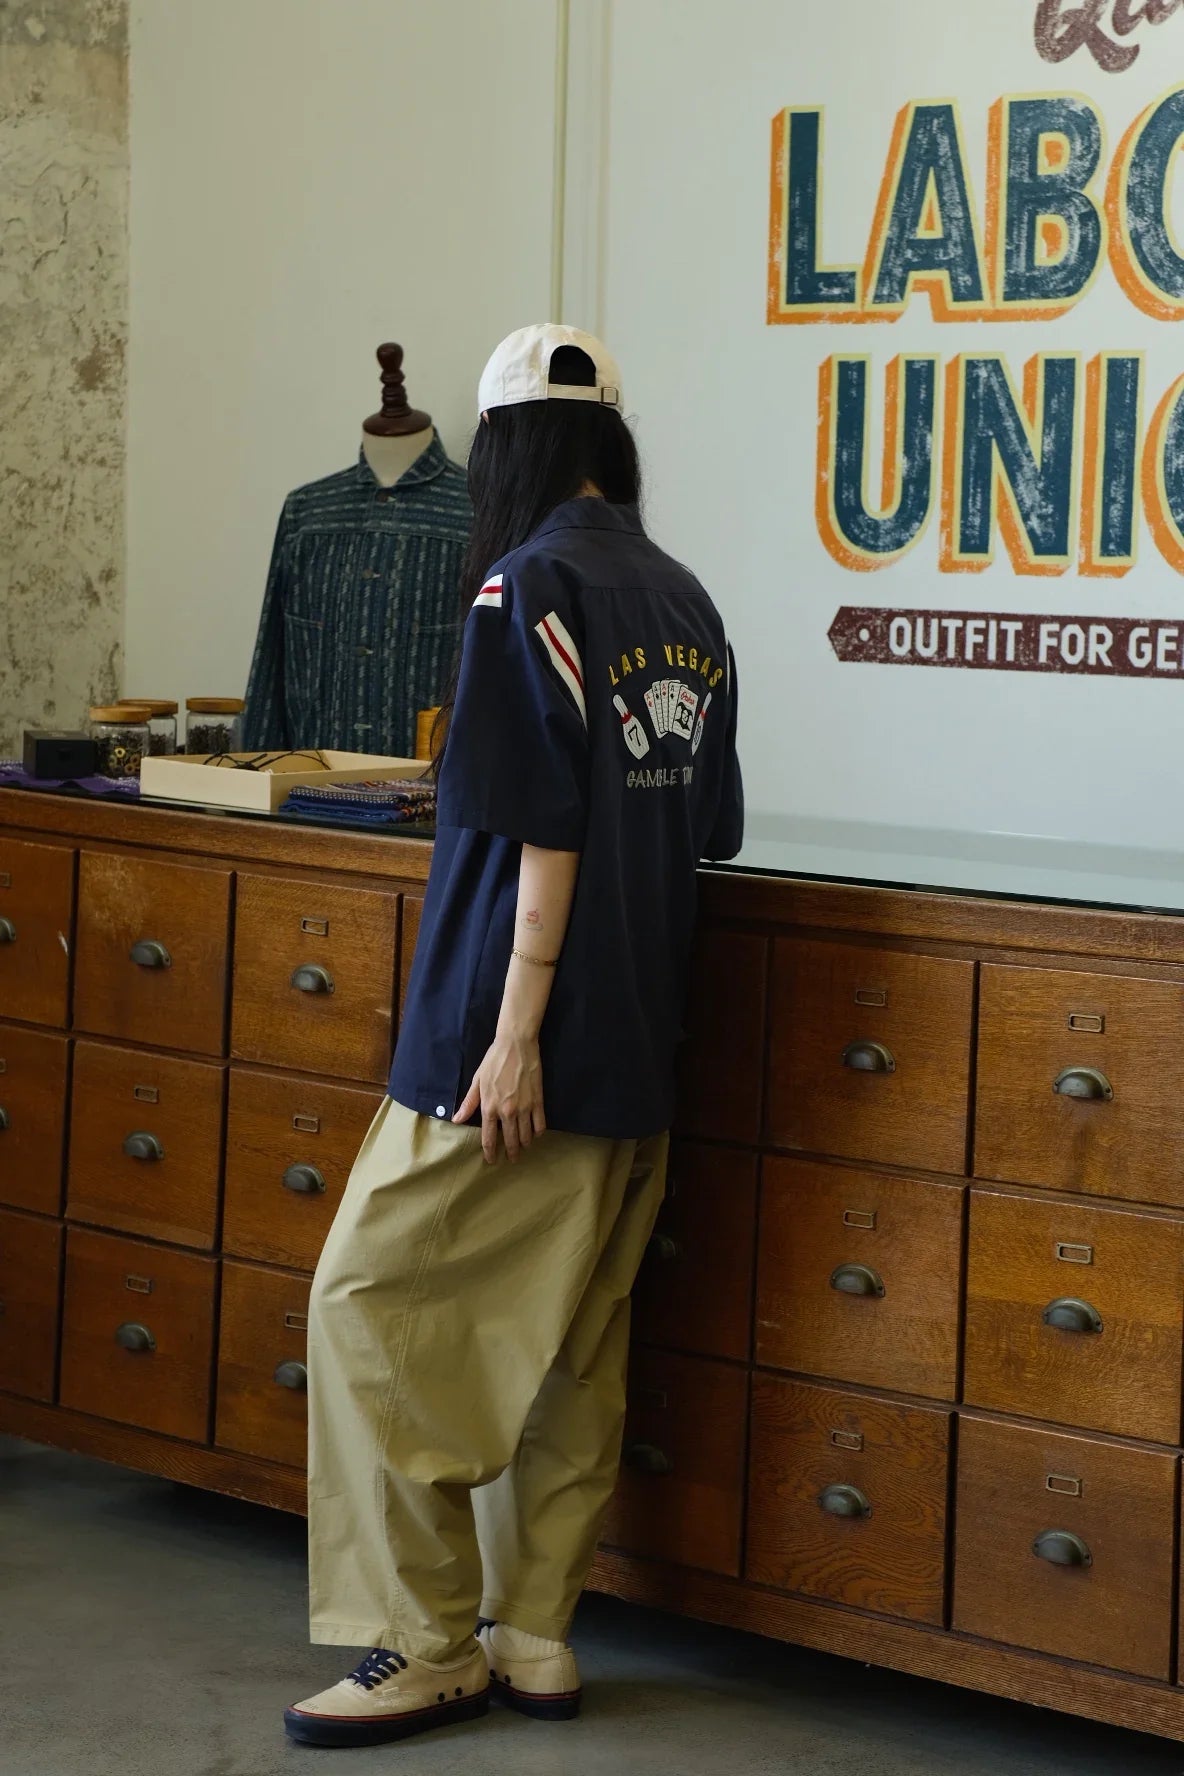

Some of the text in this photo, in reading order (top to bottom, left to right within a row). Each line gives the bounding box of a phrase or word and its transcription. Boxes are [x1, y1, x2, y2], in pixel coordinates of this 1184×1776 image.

[815, 350, 1184, 577] UNI
[608, 644, 723, 688] LAS VEGAS
[889, 616, 1184, 671] OUTFIT FOR GE
[628, 725, 642, 747] 7
